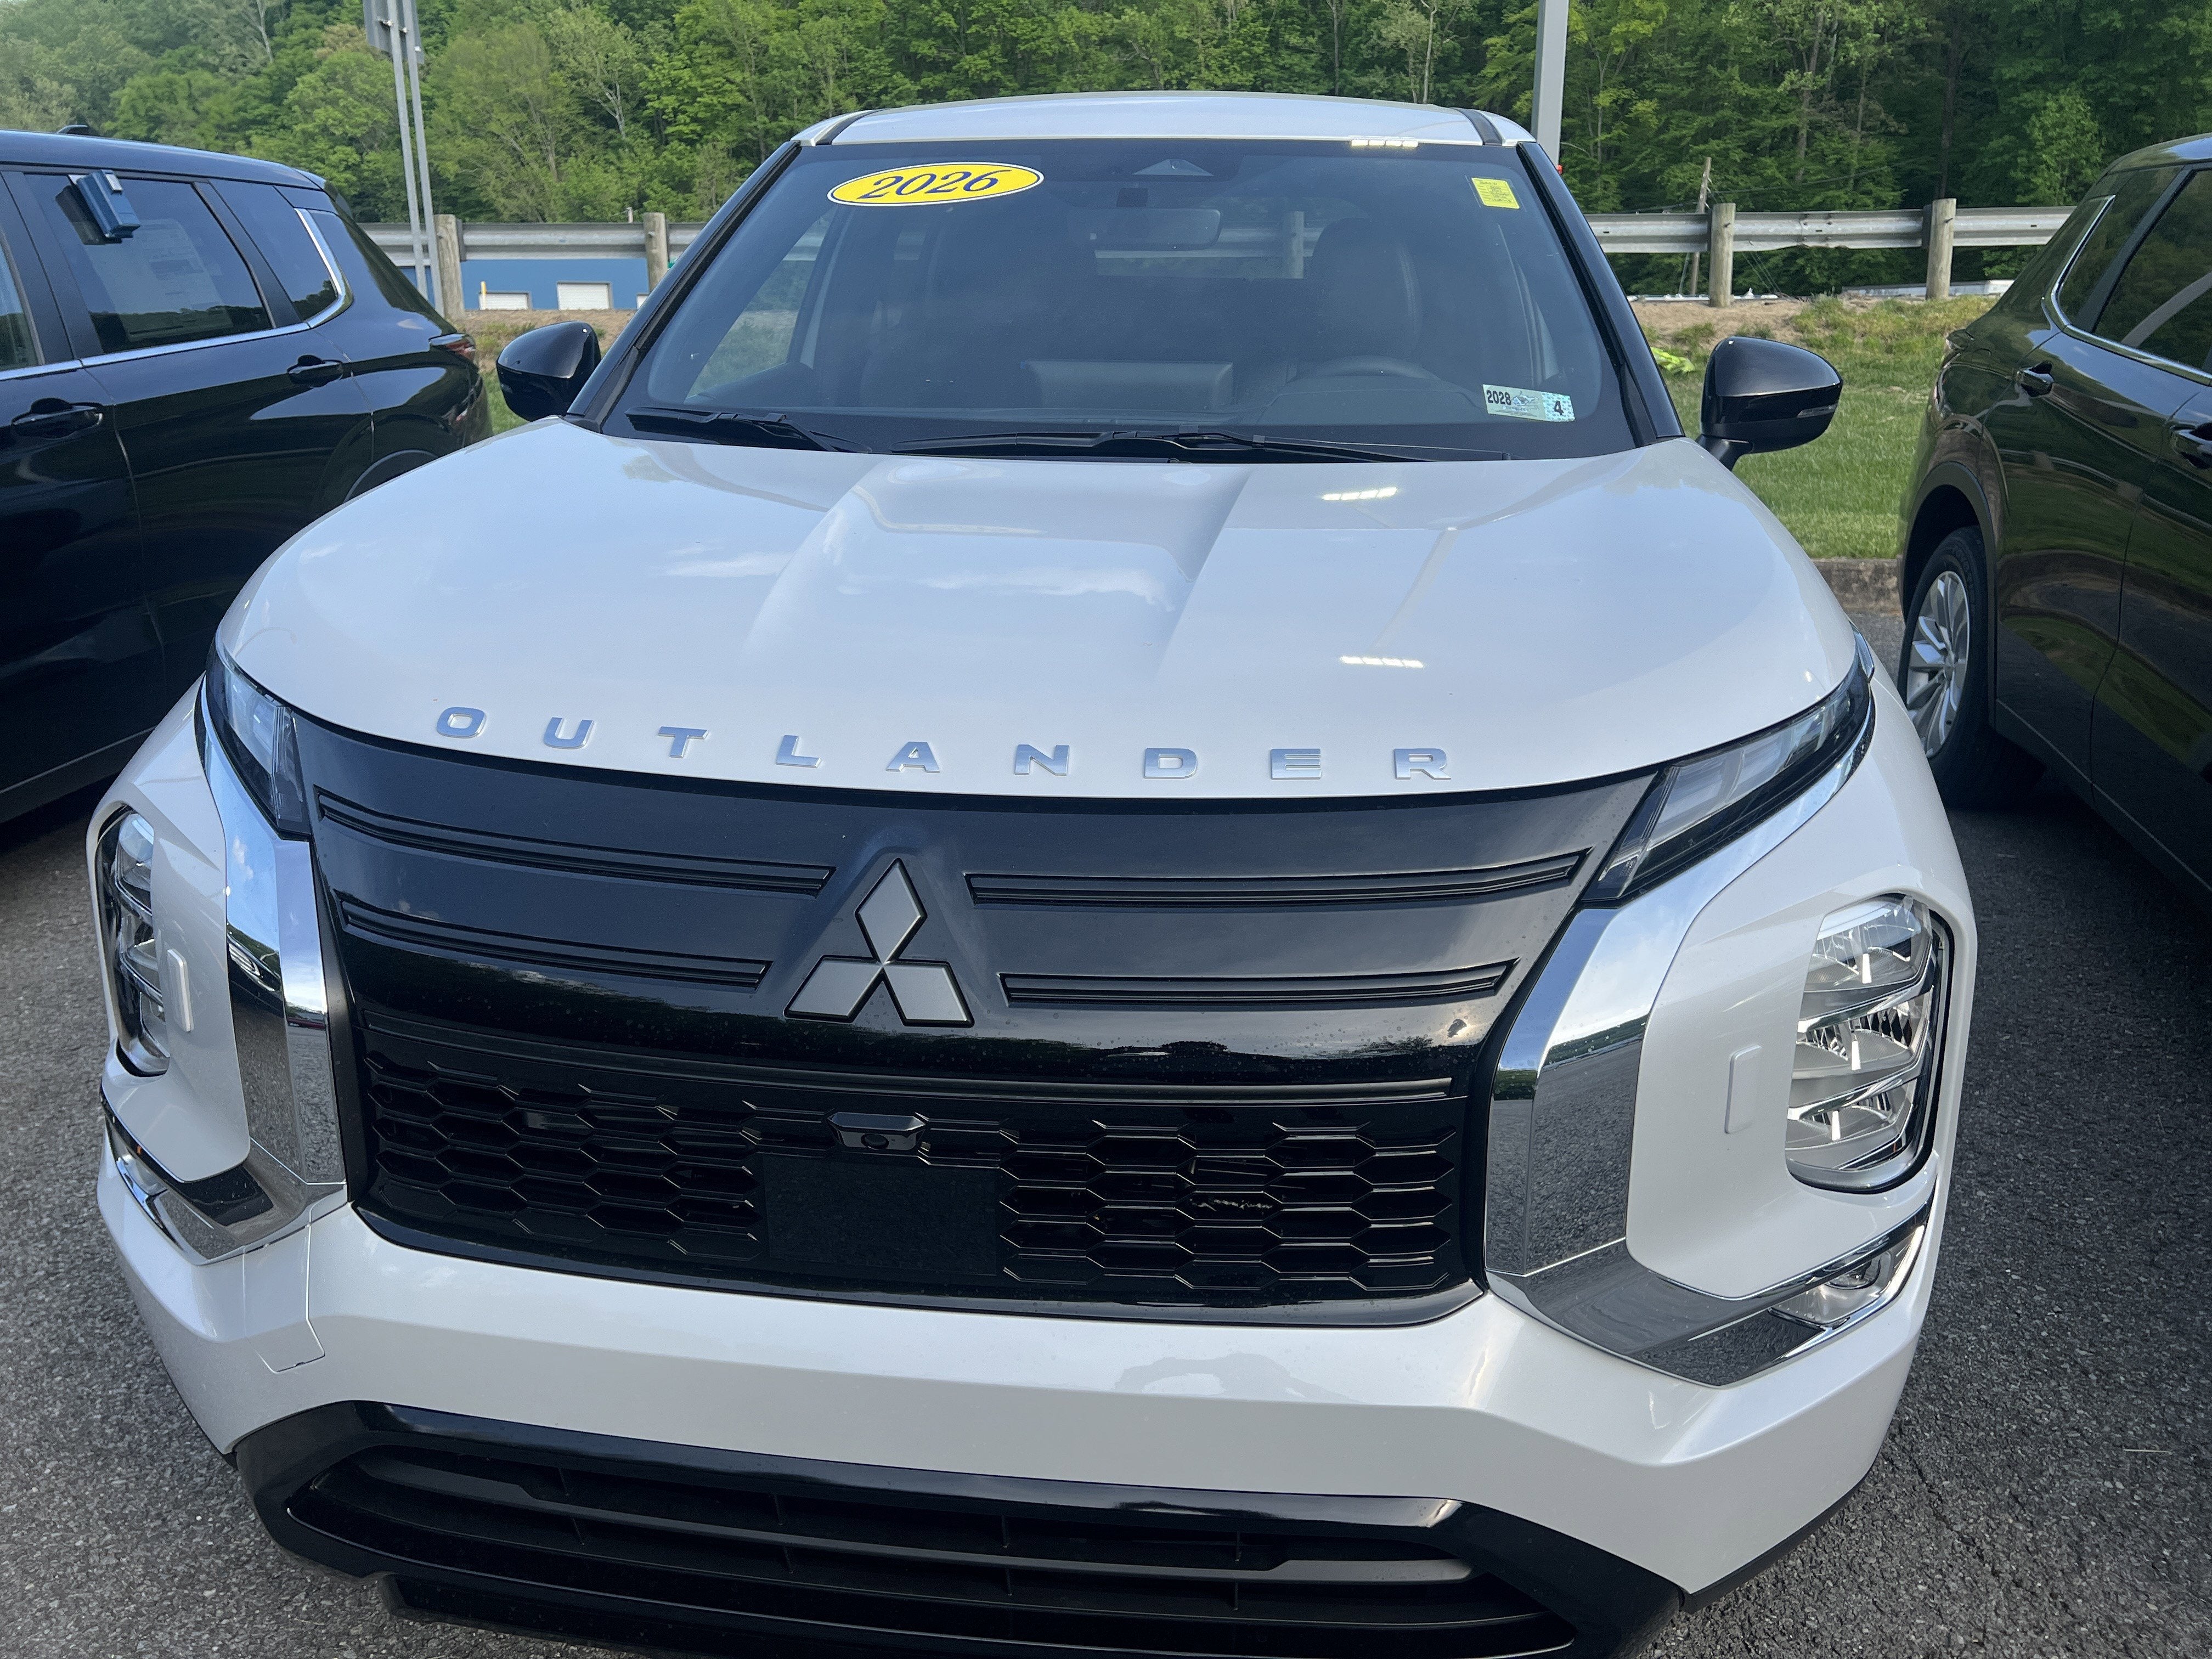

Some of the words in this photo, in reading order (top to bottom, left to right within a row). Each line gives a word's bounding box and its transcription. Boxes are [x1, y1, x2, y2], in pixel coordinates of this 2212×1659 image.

[856, 170, 1012, 199] 2026
[1487, 390, 1511, 405] 2028
[1554, 400, 1564, 415] 4
[437, 707, 1452, 780] OUTLANDER
